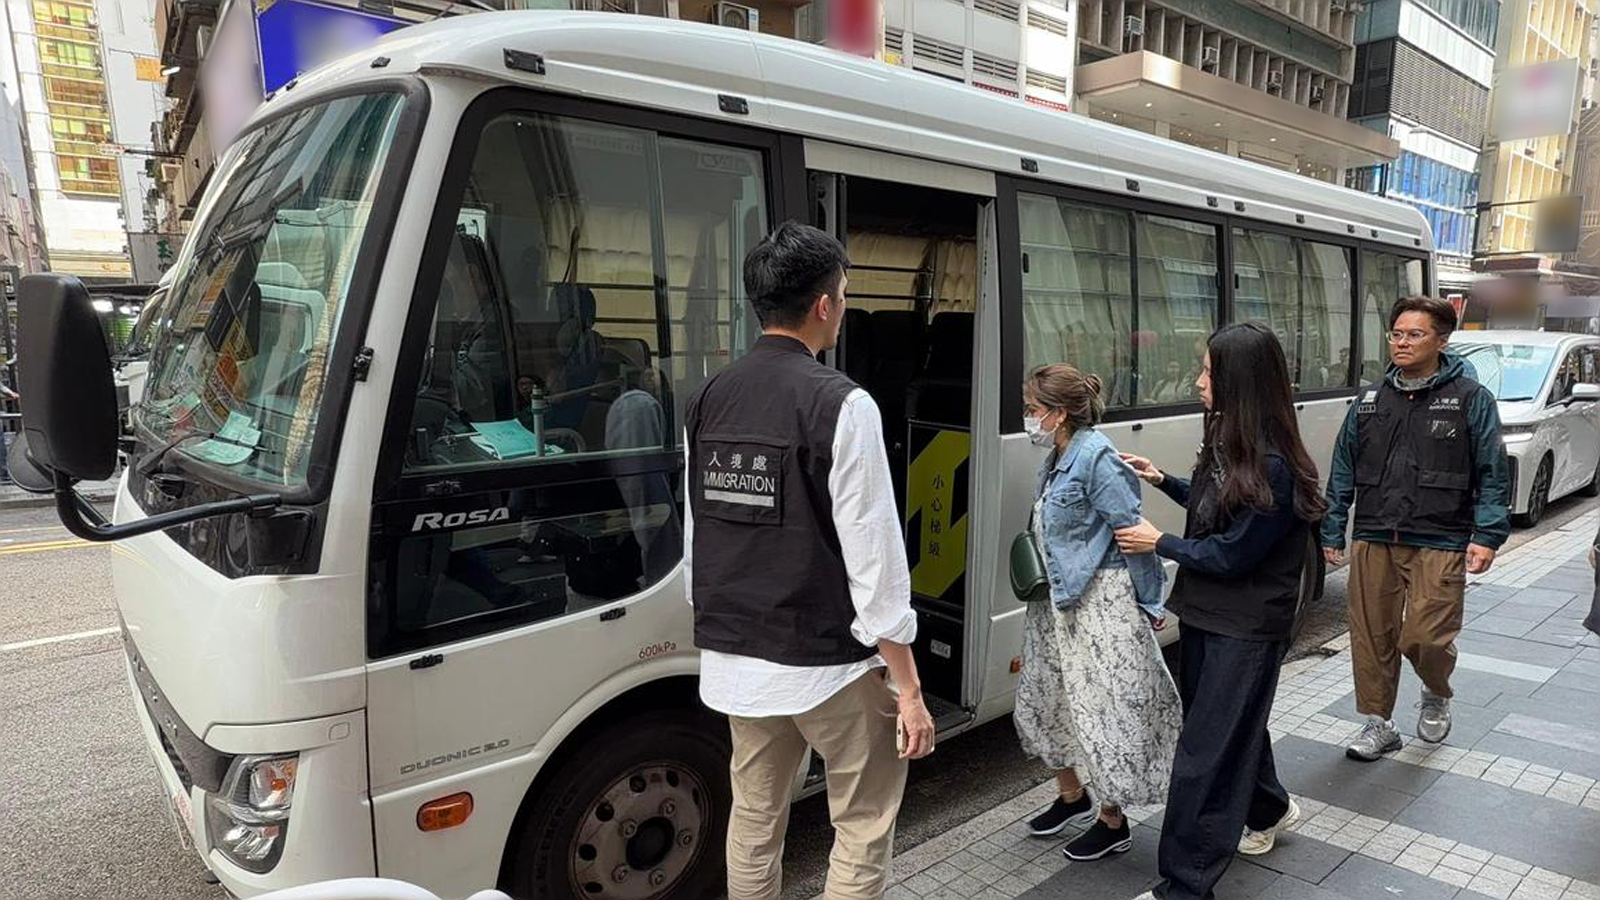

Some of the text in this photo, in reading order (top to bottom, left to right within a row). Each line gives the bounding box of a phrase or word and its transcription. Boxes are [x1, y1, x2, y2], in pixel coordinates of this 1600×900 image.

[708, 451, 767, 471] 入境處
[411, 507, 510, 532] ROSA
[638, 641, 677, 659] 600kPa
[400, 746, 481, 775] DUONIC
